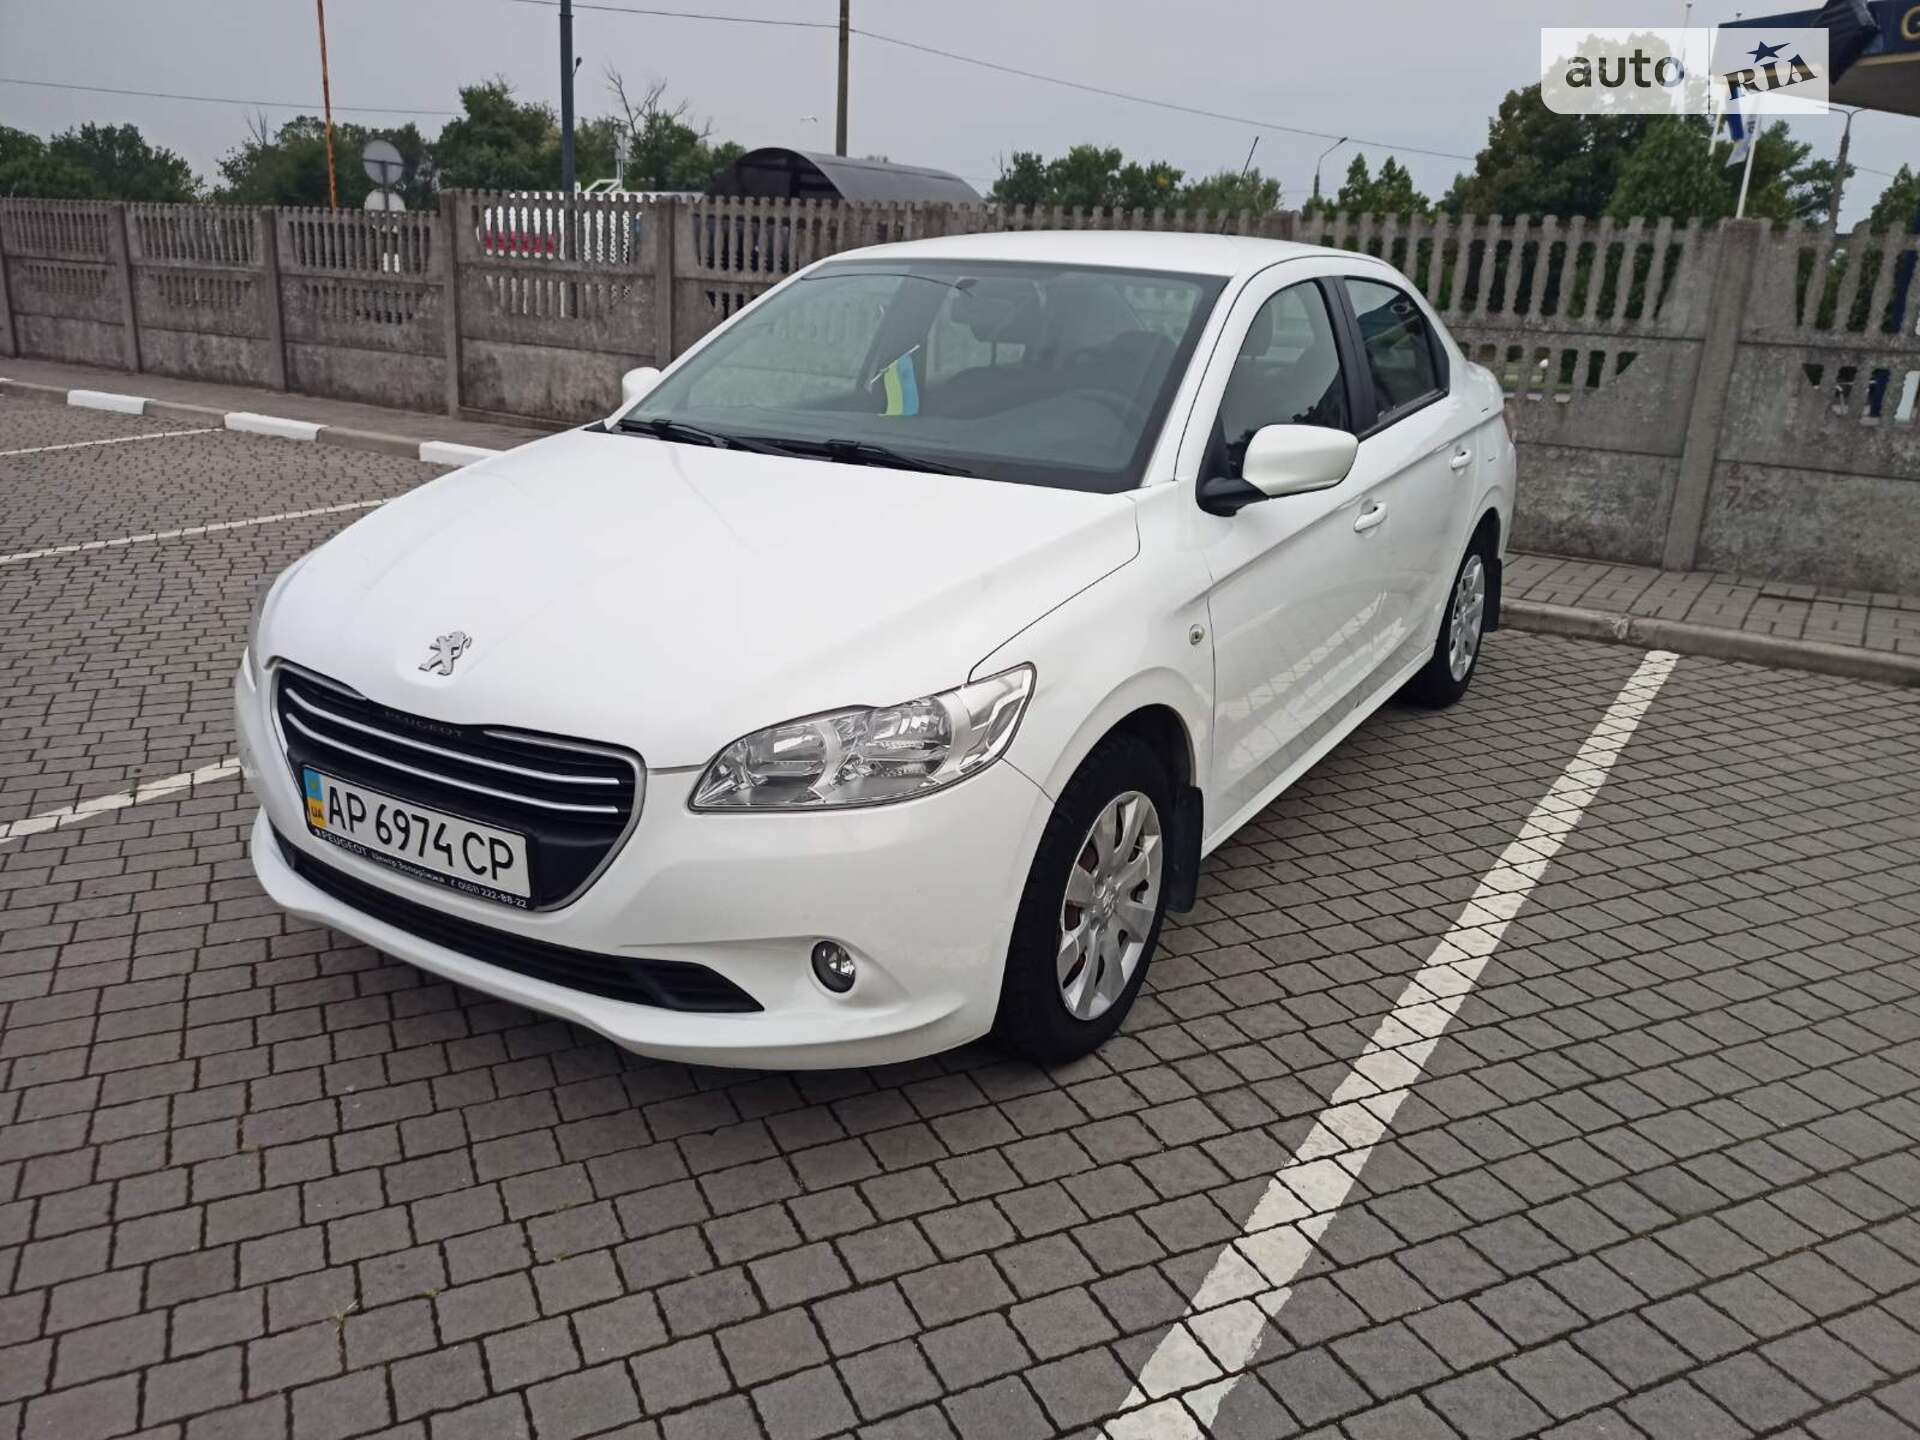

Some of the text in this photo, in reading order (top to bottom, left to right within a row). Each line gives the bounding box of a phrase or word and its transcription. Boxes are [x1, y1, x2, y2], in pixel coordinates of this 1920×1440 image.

[320, 830, 367, 856] PEUGEOT
[329, 786, 514, 881] AP 6974 CP
